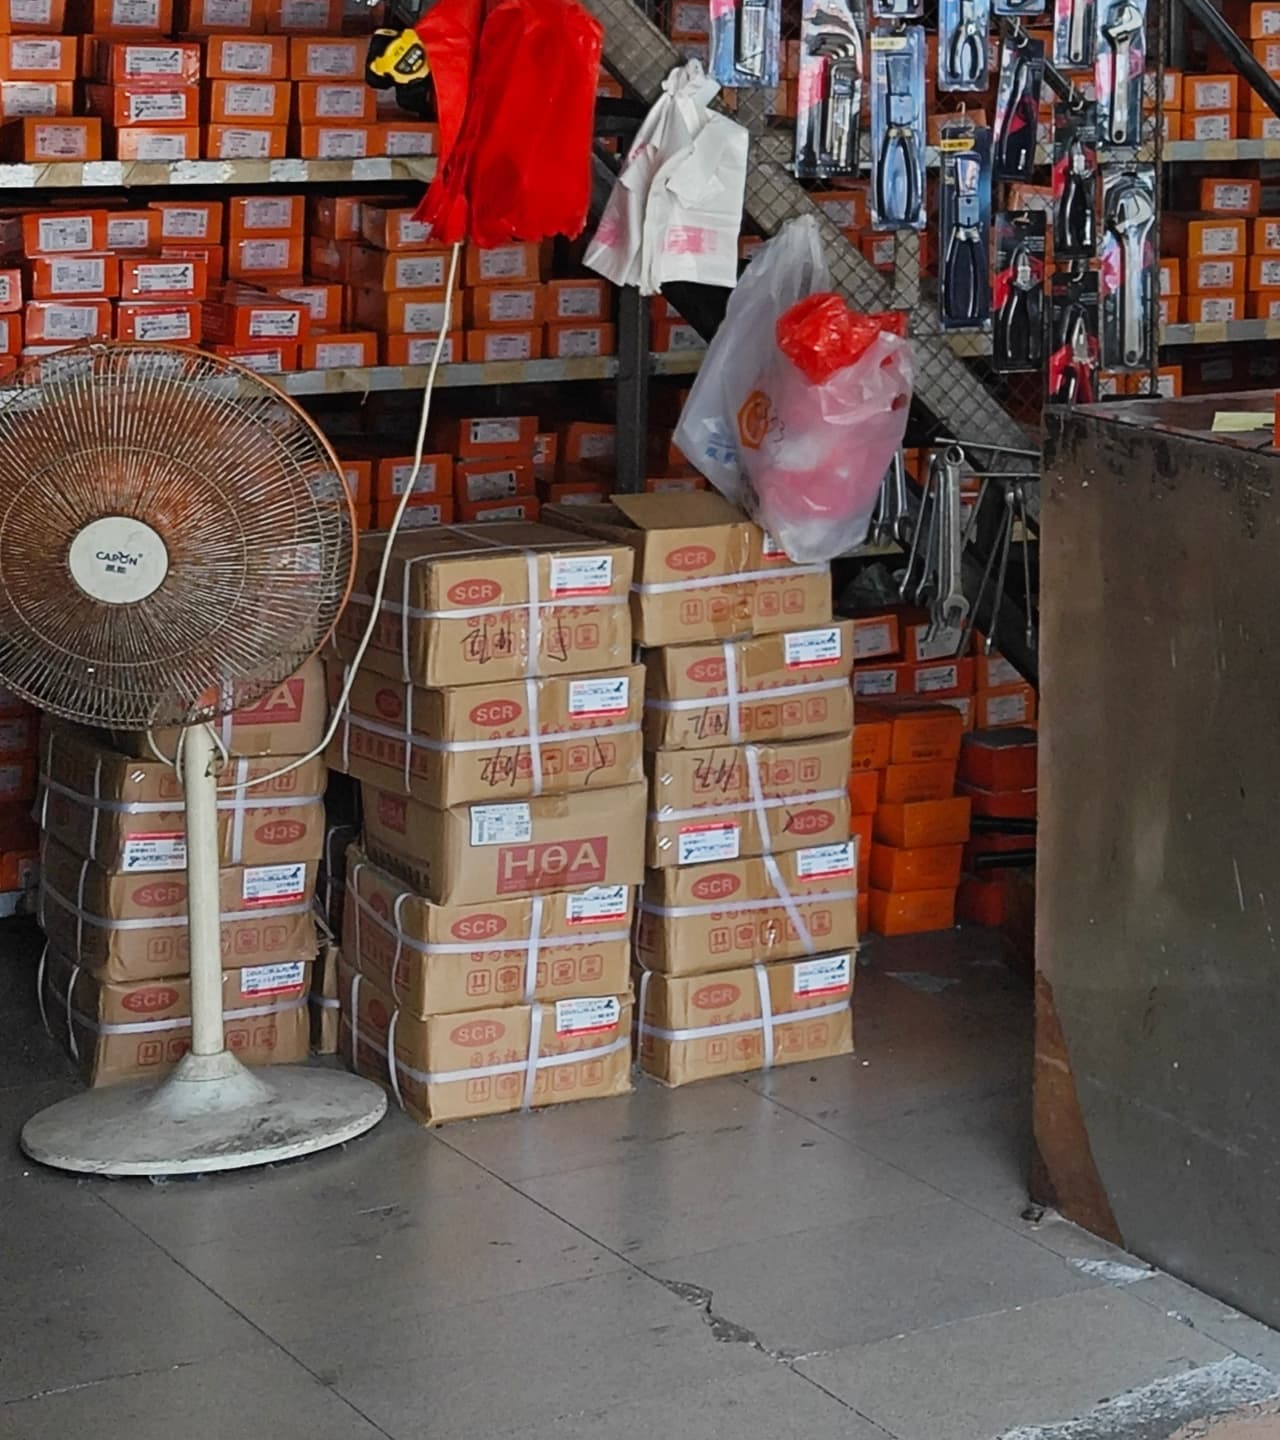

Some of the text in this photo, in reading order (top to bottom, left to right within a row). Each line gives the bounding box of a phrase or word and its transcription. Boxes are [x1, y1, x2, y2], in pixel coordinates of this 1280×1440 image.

[672, 552, 708, 565] SCR
[455, 585, 493, 601] SCR
[477, 705, 515, 722] SCR
[698, 880, 733, 893] SCR
[459, 919, 498, 934] SCR
[131, 993, 171, 1007] SCR
[699, 989, 733, 1003] SCR
[457, 1026, 497, 1042] SCR
